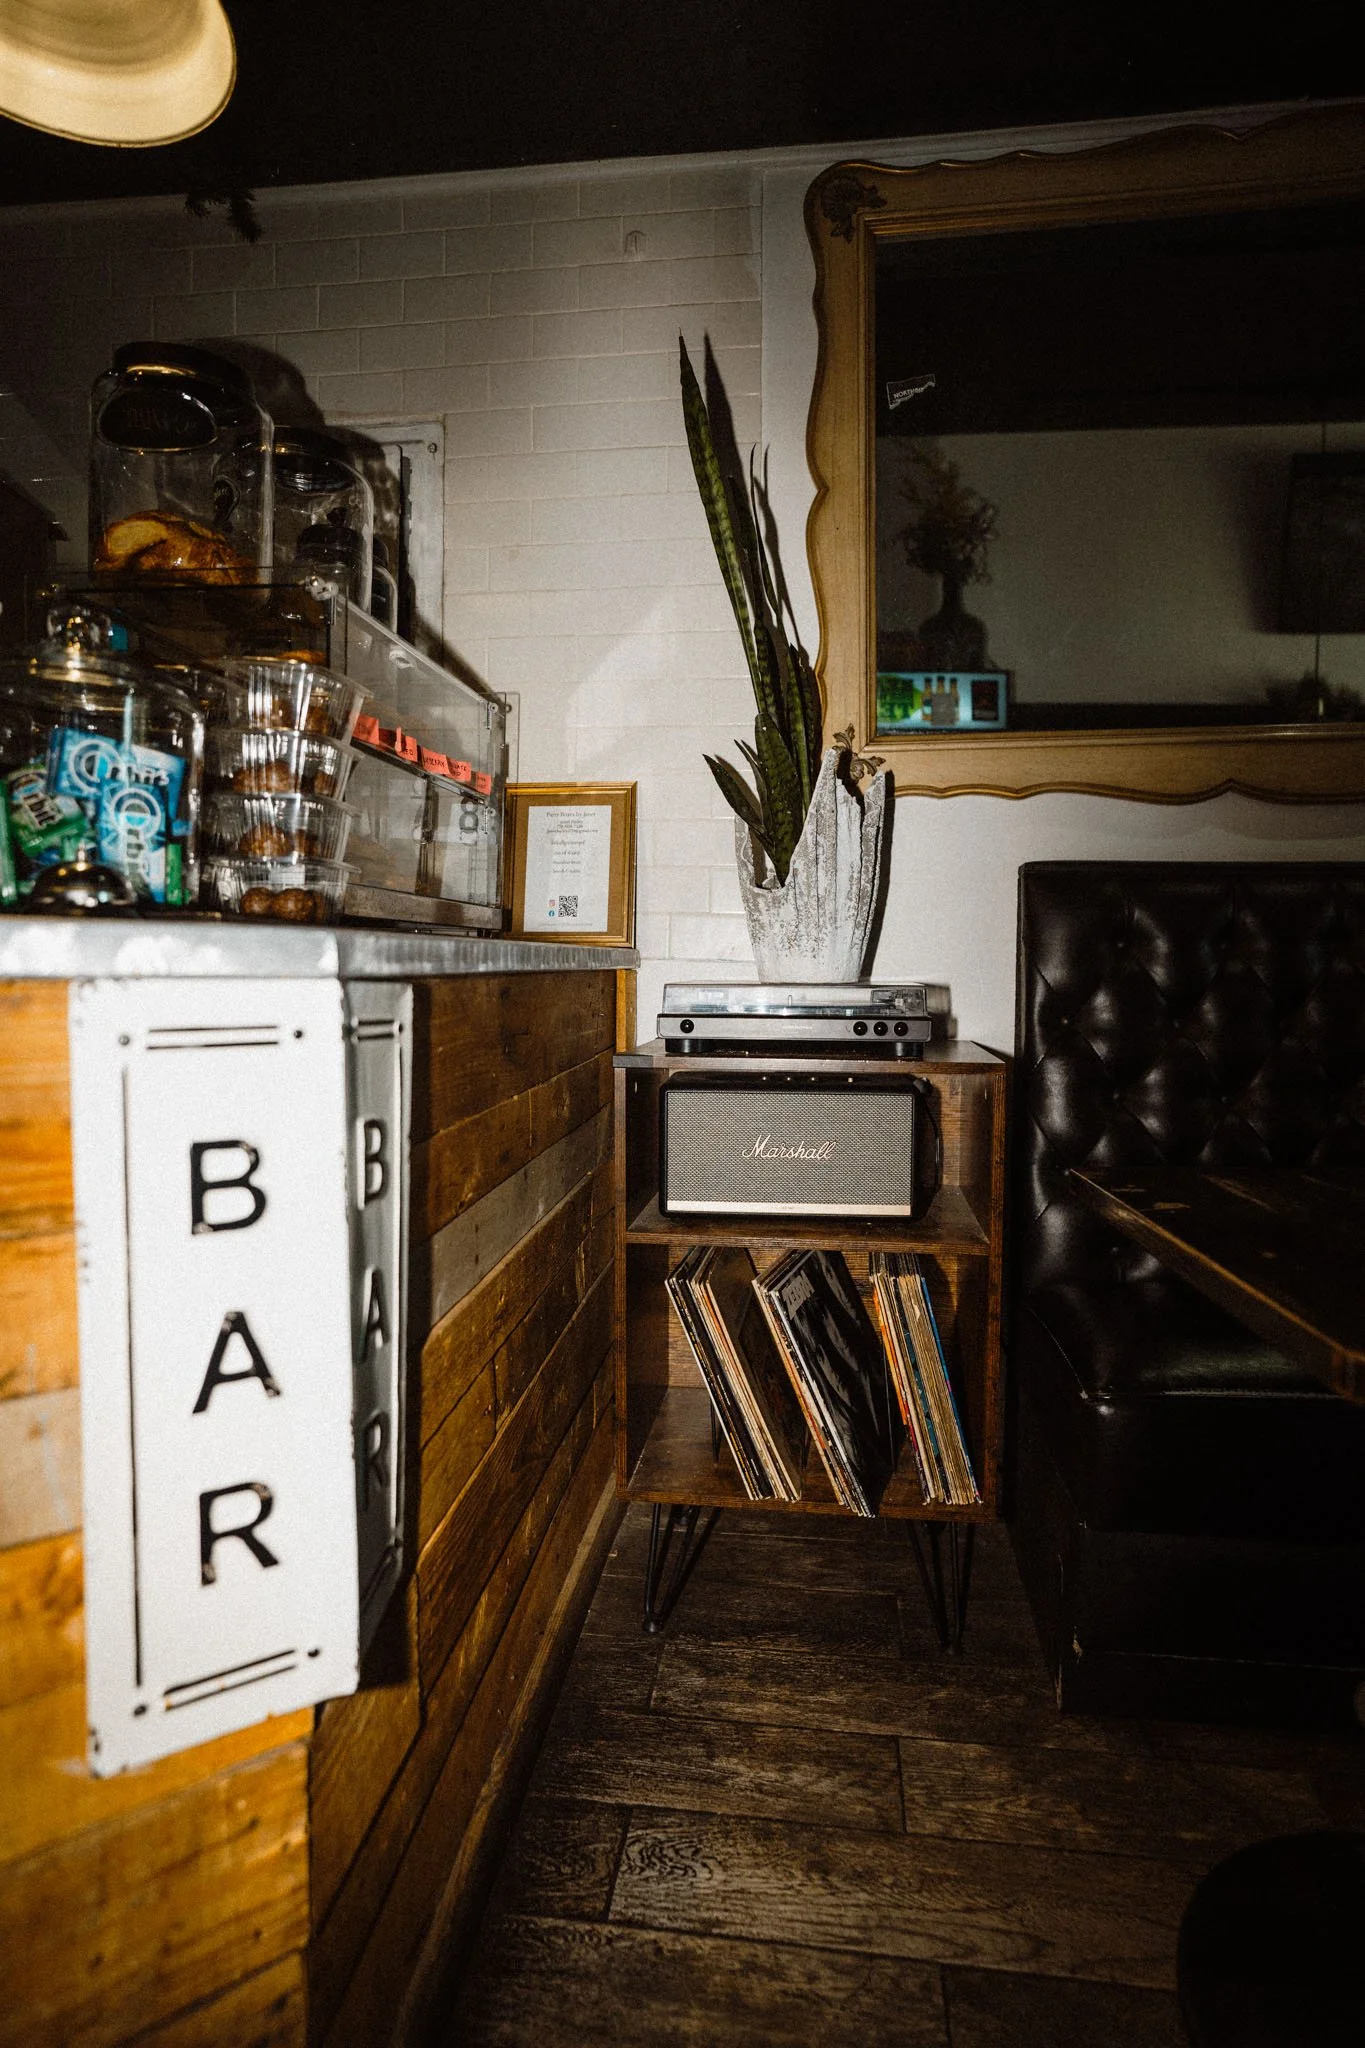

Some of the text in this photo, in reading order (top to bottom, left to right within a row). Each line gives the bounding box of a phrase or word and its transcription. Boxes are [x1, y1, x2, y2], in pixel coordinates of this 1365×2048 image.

[356, 1117, 390, 1511] BAR
[742, 1135, 836, 1159] Marshall
[190, 1140, 281, 1586] BAR
